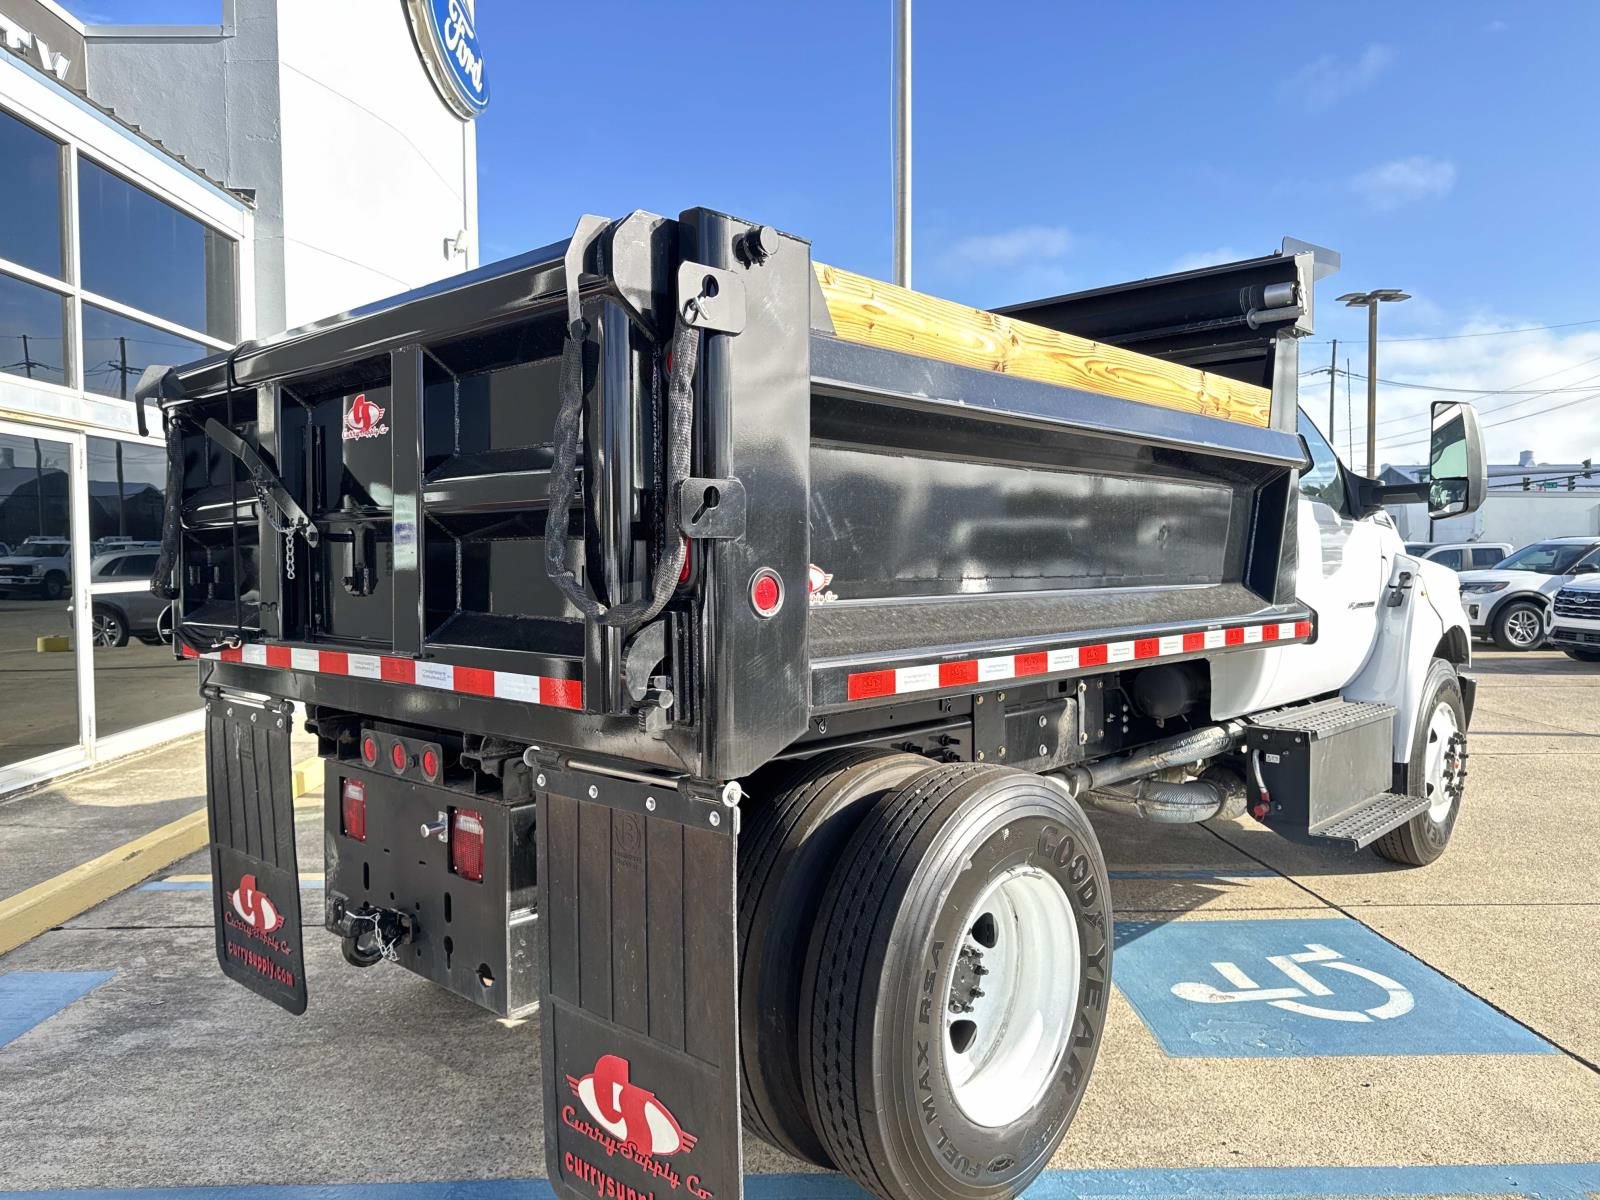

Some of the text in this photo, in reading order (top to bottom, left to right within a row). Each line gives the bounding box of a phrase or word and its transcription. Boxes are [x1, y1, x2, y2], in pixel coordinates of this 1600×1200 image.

[445, 0, 482, 93] Ford
[225, 911, 254, 938] Curry
[228, 941, 295, 988] currysupply.com
[1038, 825, 1105, 1094] GOODYEAR
[917, 941, 982, 1179] FUEL MAX RSA
[562, 1105, 712, 1200] Curry Supply Co
